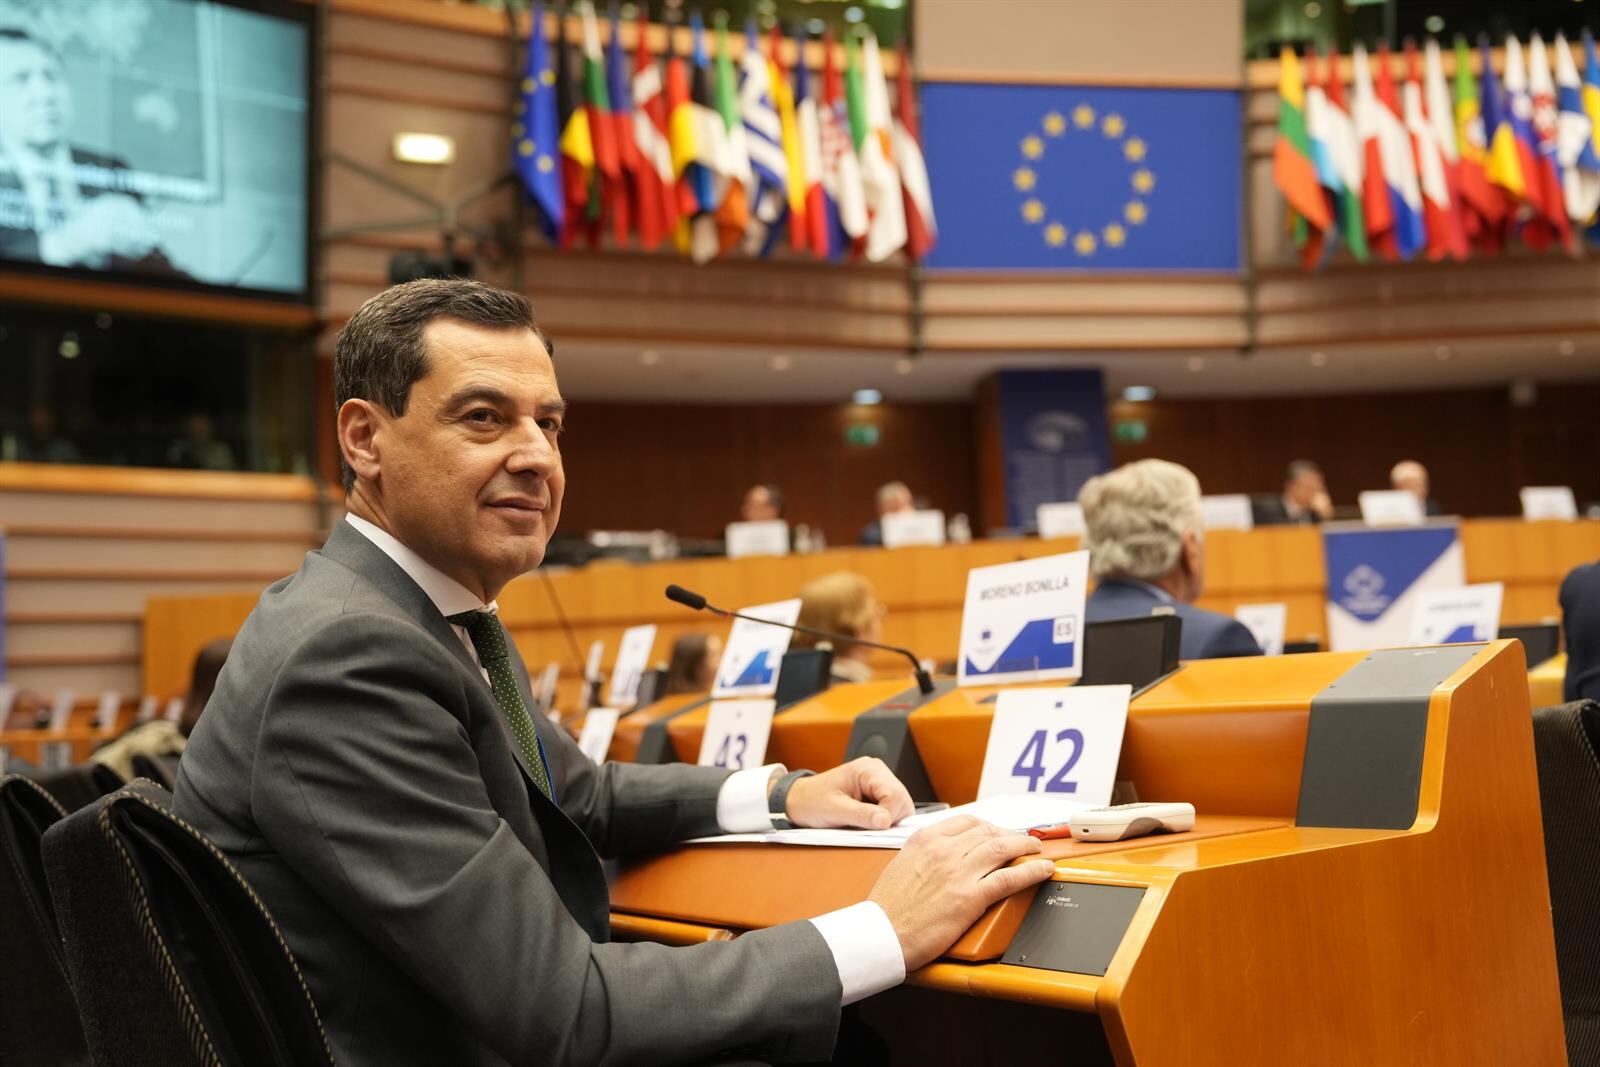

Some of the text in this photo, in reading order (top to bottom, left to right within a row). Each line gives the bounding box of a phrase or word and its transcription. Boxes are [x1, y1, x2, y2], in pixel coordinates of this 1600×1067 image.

[980, 576, 1069, 601] MORENO BONILLA
[1056, 622, 1072, 637] ES
[714, 733, 747, 769] 43
[1011, 728, 1084, 793] 42
